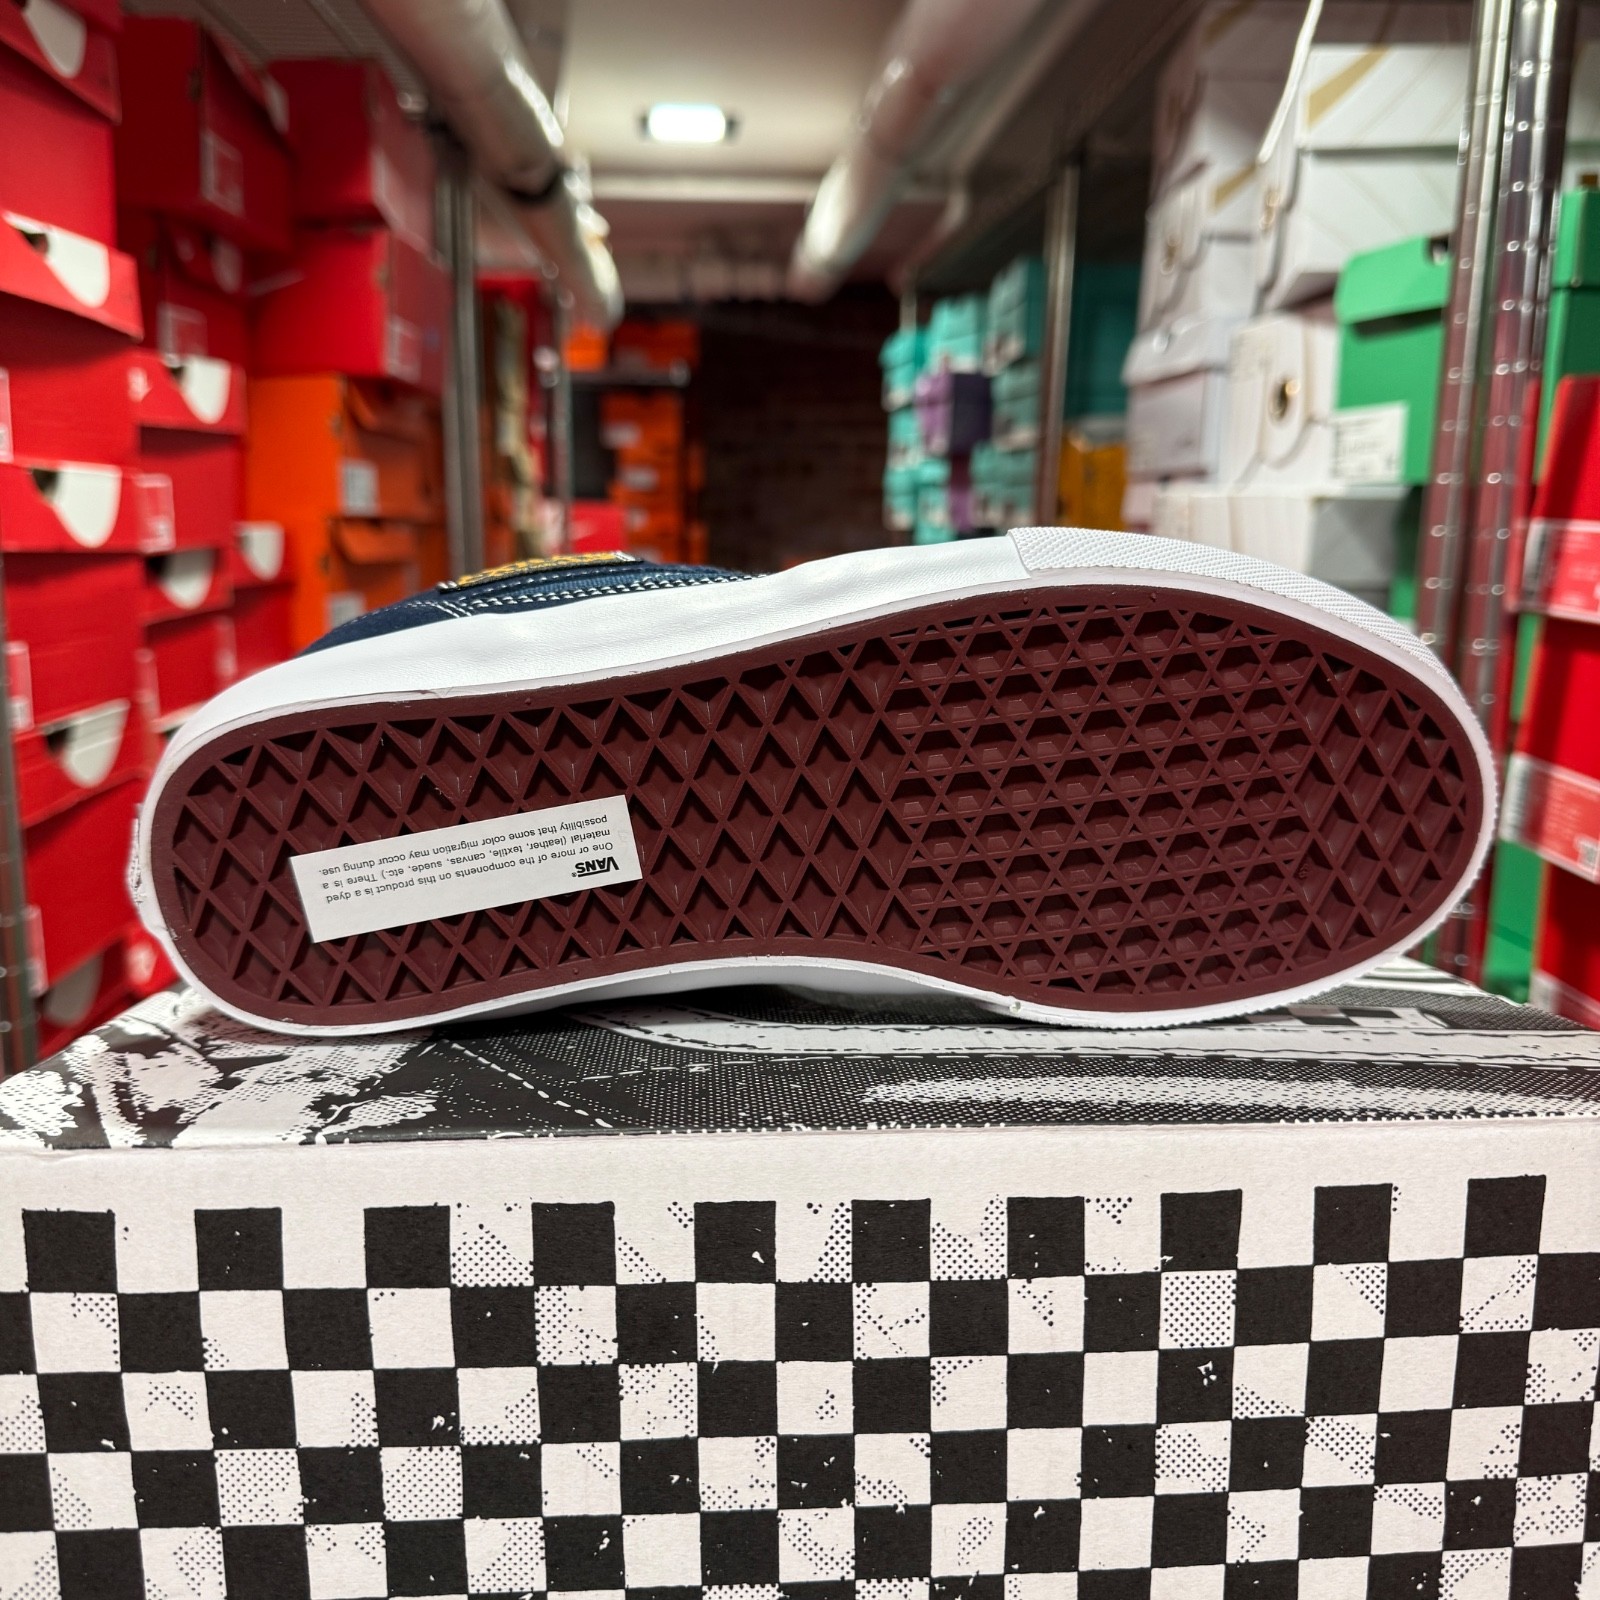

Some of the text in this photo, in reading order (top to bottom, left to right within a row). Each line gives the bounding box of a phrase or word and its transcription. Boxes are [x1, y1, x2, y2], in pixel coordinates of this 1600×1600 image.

[319, 814, 608, 876] possibility that some color migration may occur during use.
[322, 829, 611, 890] material (leather, textile, canvas, suede, etc.) There is a
[326, 842, 613, 904] One or more of the components on this product is a dyed
